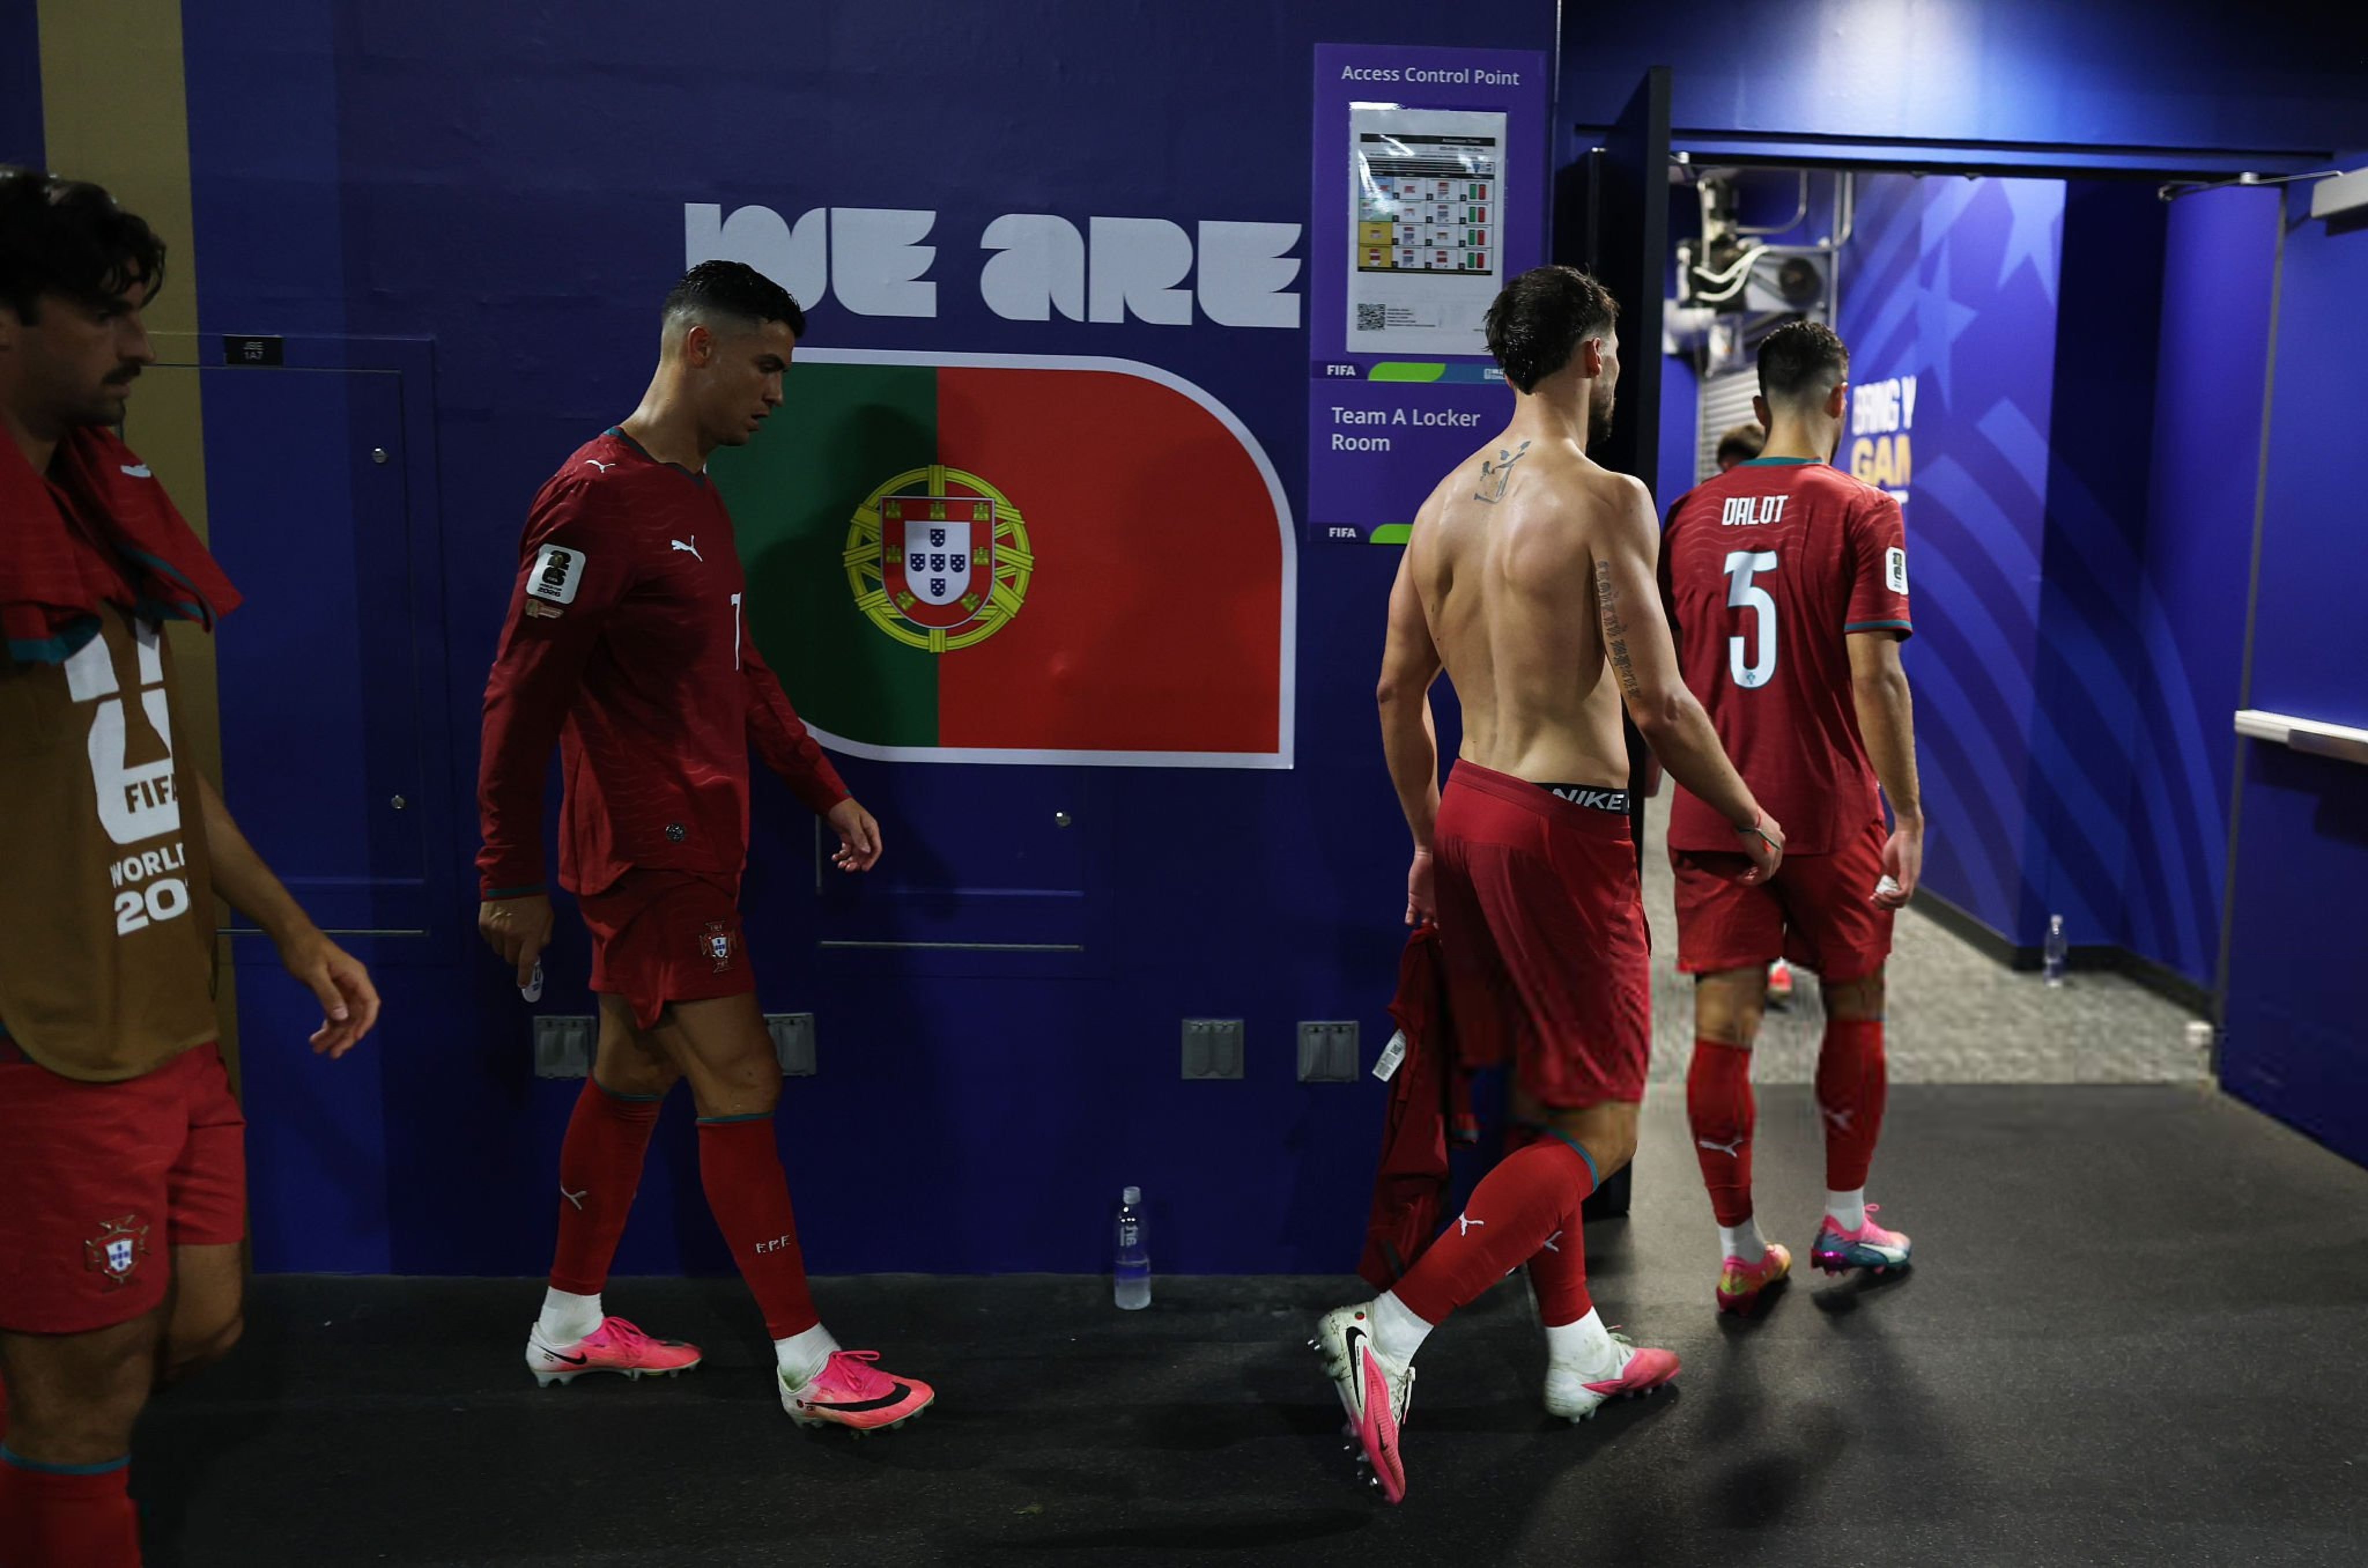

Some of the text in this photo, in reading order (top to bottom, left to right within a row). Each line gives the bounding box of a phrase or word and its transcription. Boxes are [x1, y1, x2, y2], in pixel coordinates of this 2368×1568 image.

[1341, 65, 1520, 86] Access Control Point
[684, 203, 937, 318] WE
[1326, 364, 1356, 376] FIFA
[1331, 406, 1481, 427] Team A Locker
[1331, 433, 1391, 452] Room
[1721, 494, 1789, 526] DALOT
[1329, 527, 1357, 538] FIFA
[1723, 550, 1779, 689] 5
[1552, 788, 1626, 811] NIKE
[114, 877, 191, 937] 20
